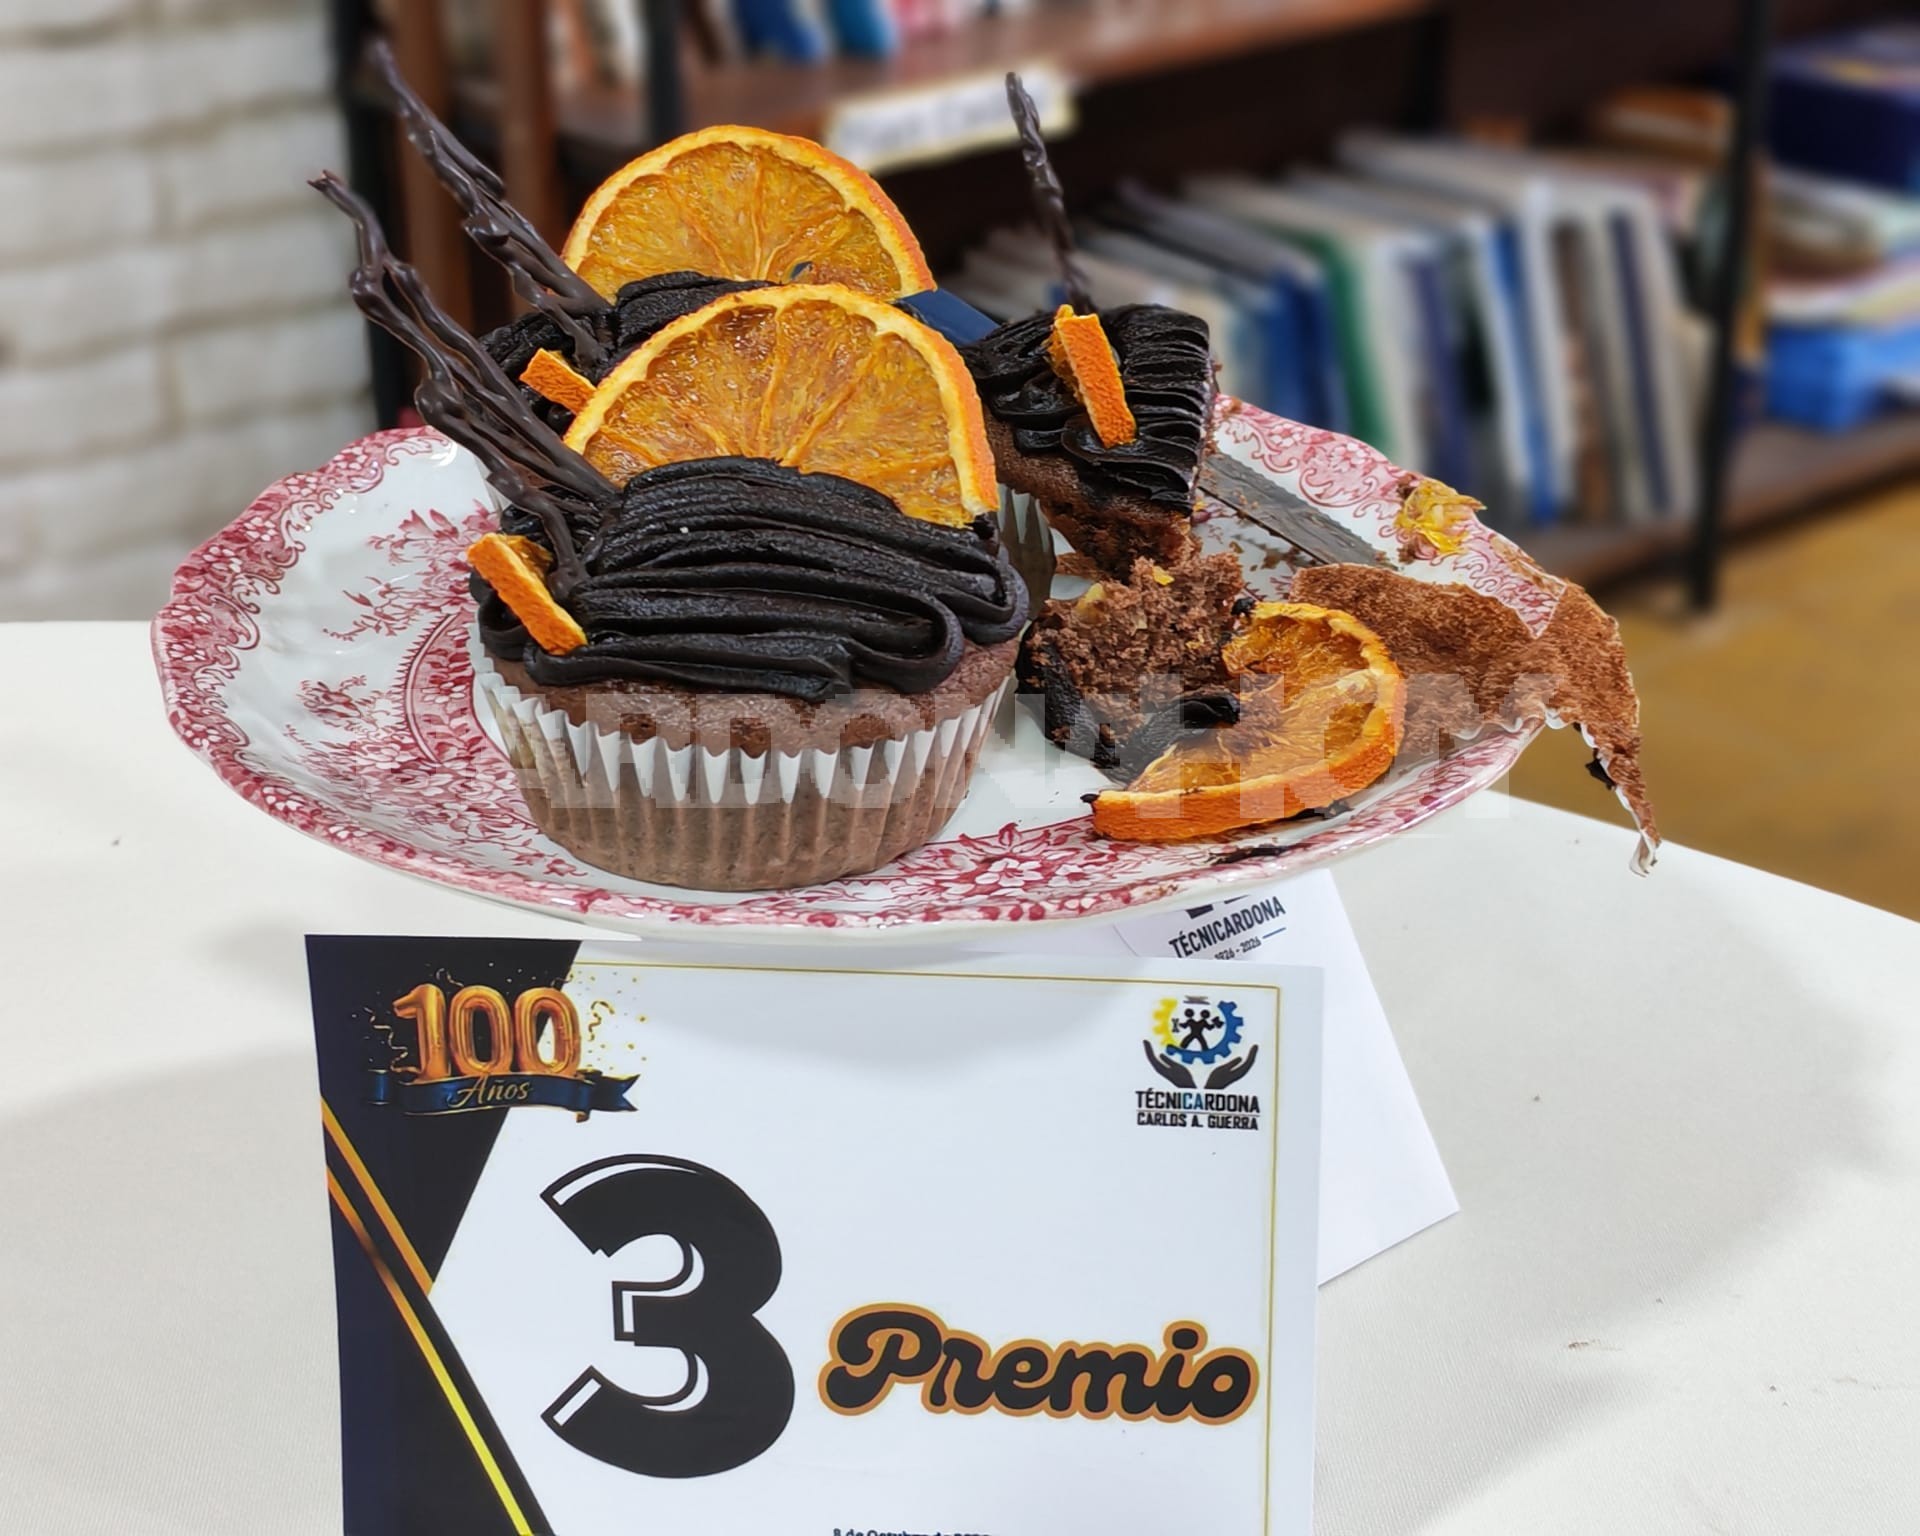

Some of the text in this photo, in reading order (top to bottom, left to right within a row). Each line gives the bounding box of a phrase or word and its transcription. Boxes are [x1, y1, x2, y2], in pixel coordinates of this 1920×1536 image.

[1168, 896, 1286, 958] TÉCNICARDONA
[393, 983, 581, 1080] 100
[447, 1076, 532, 1107] Años
[1135, 1088, 1260, 1114] TÉCNICARDONA
[1137, 1112, 1258, 1130] CARLOS A. GUERRA
[541, 1153, 796, 1478] 3
[820, 1304, 1258, 1424] Premio
